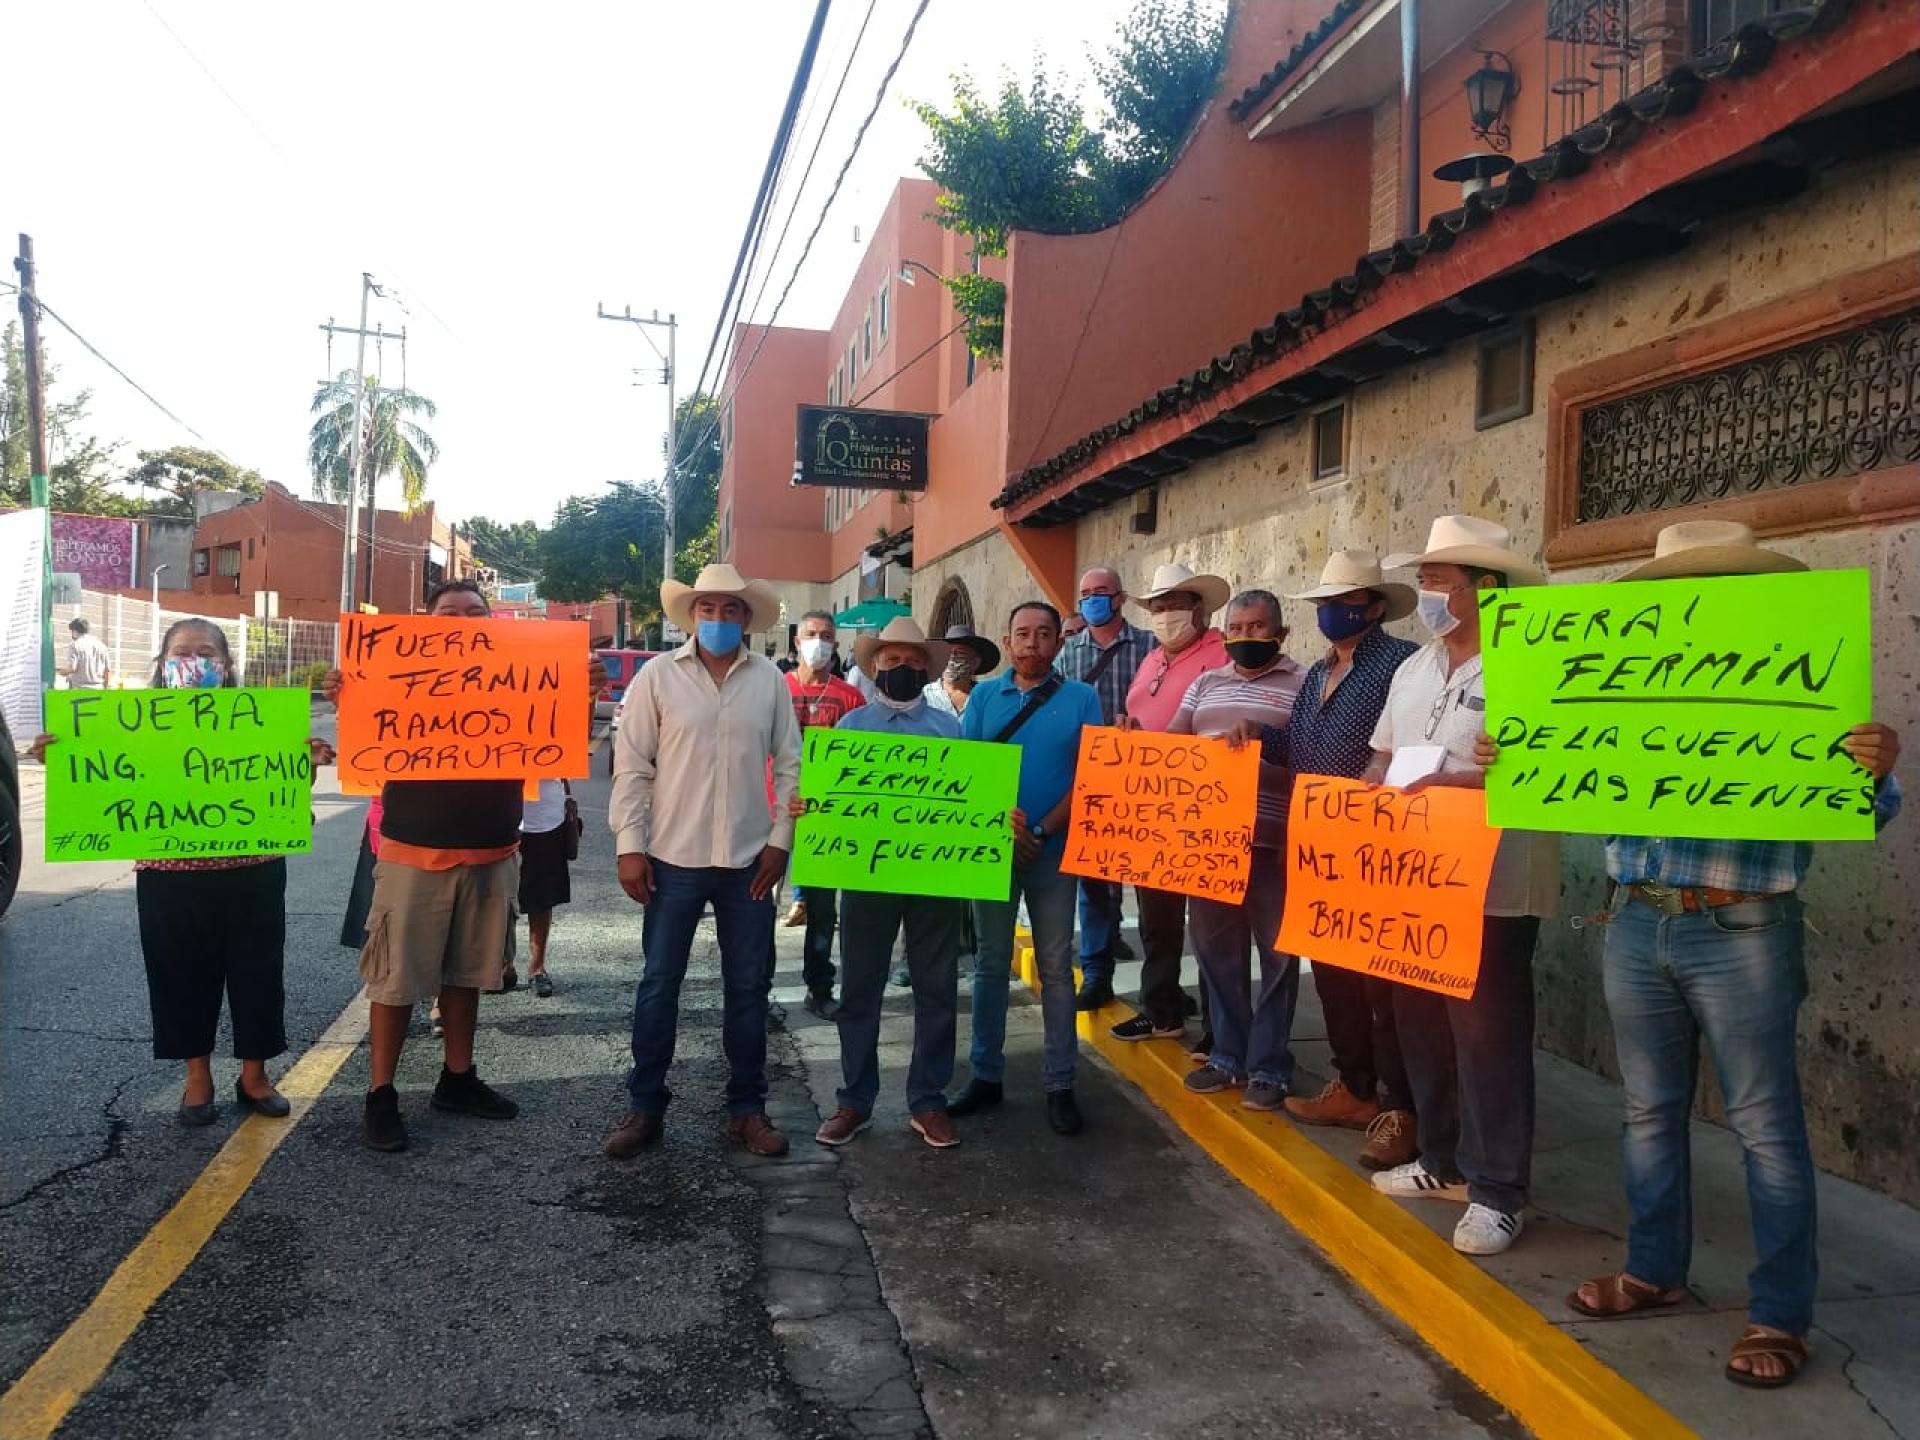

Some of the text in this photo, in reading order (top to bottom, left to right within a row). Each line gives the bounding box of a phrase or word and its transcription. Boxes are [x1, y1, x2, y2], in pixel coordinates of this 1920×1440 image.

[826, 440, 912, 472] Quintas
[389, 661, 559, 699] FERMIN
[70, 692, 265, 737] FUERA
[69, 746, 311, 784] ING. ARTEMIO
[350, 742, 563, 773] CORRUPTO
[1088, 735, 1207, 772] EJIDOS
[1125, 773, 1229, 803] UNIDOS
[892, 805, 1007, 829] CUENCA
[1303, 782, 1429, 832] FUERA
[1077, 846, 1240, 871] LUIS ACOSTA
[1354, 843, 1470, 889] RAFAEL
[1308, 900, 1449, 960] BRISEÑO
